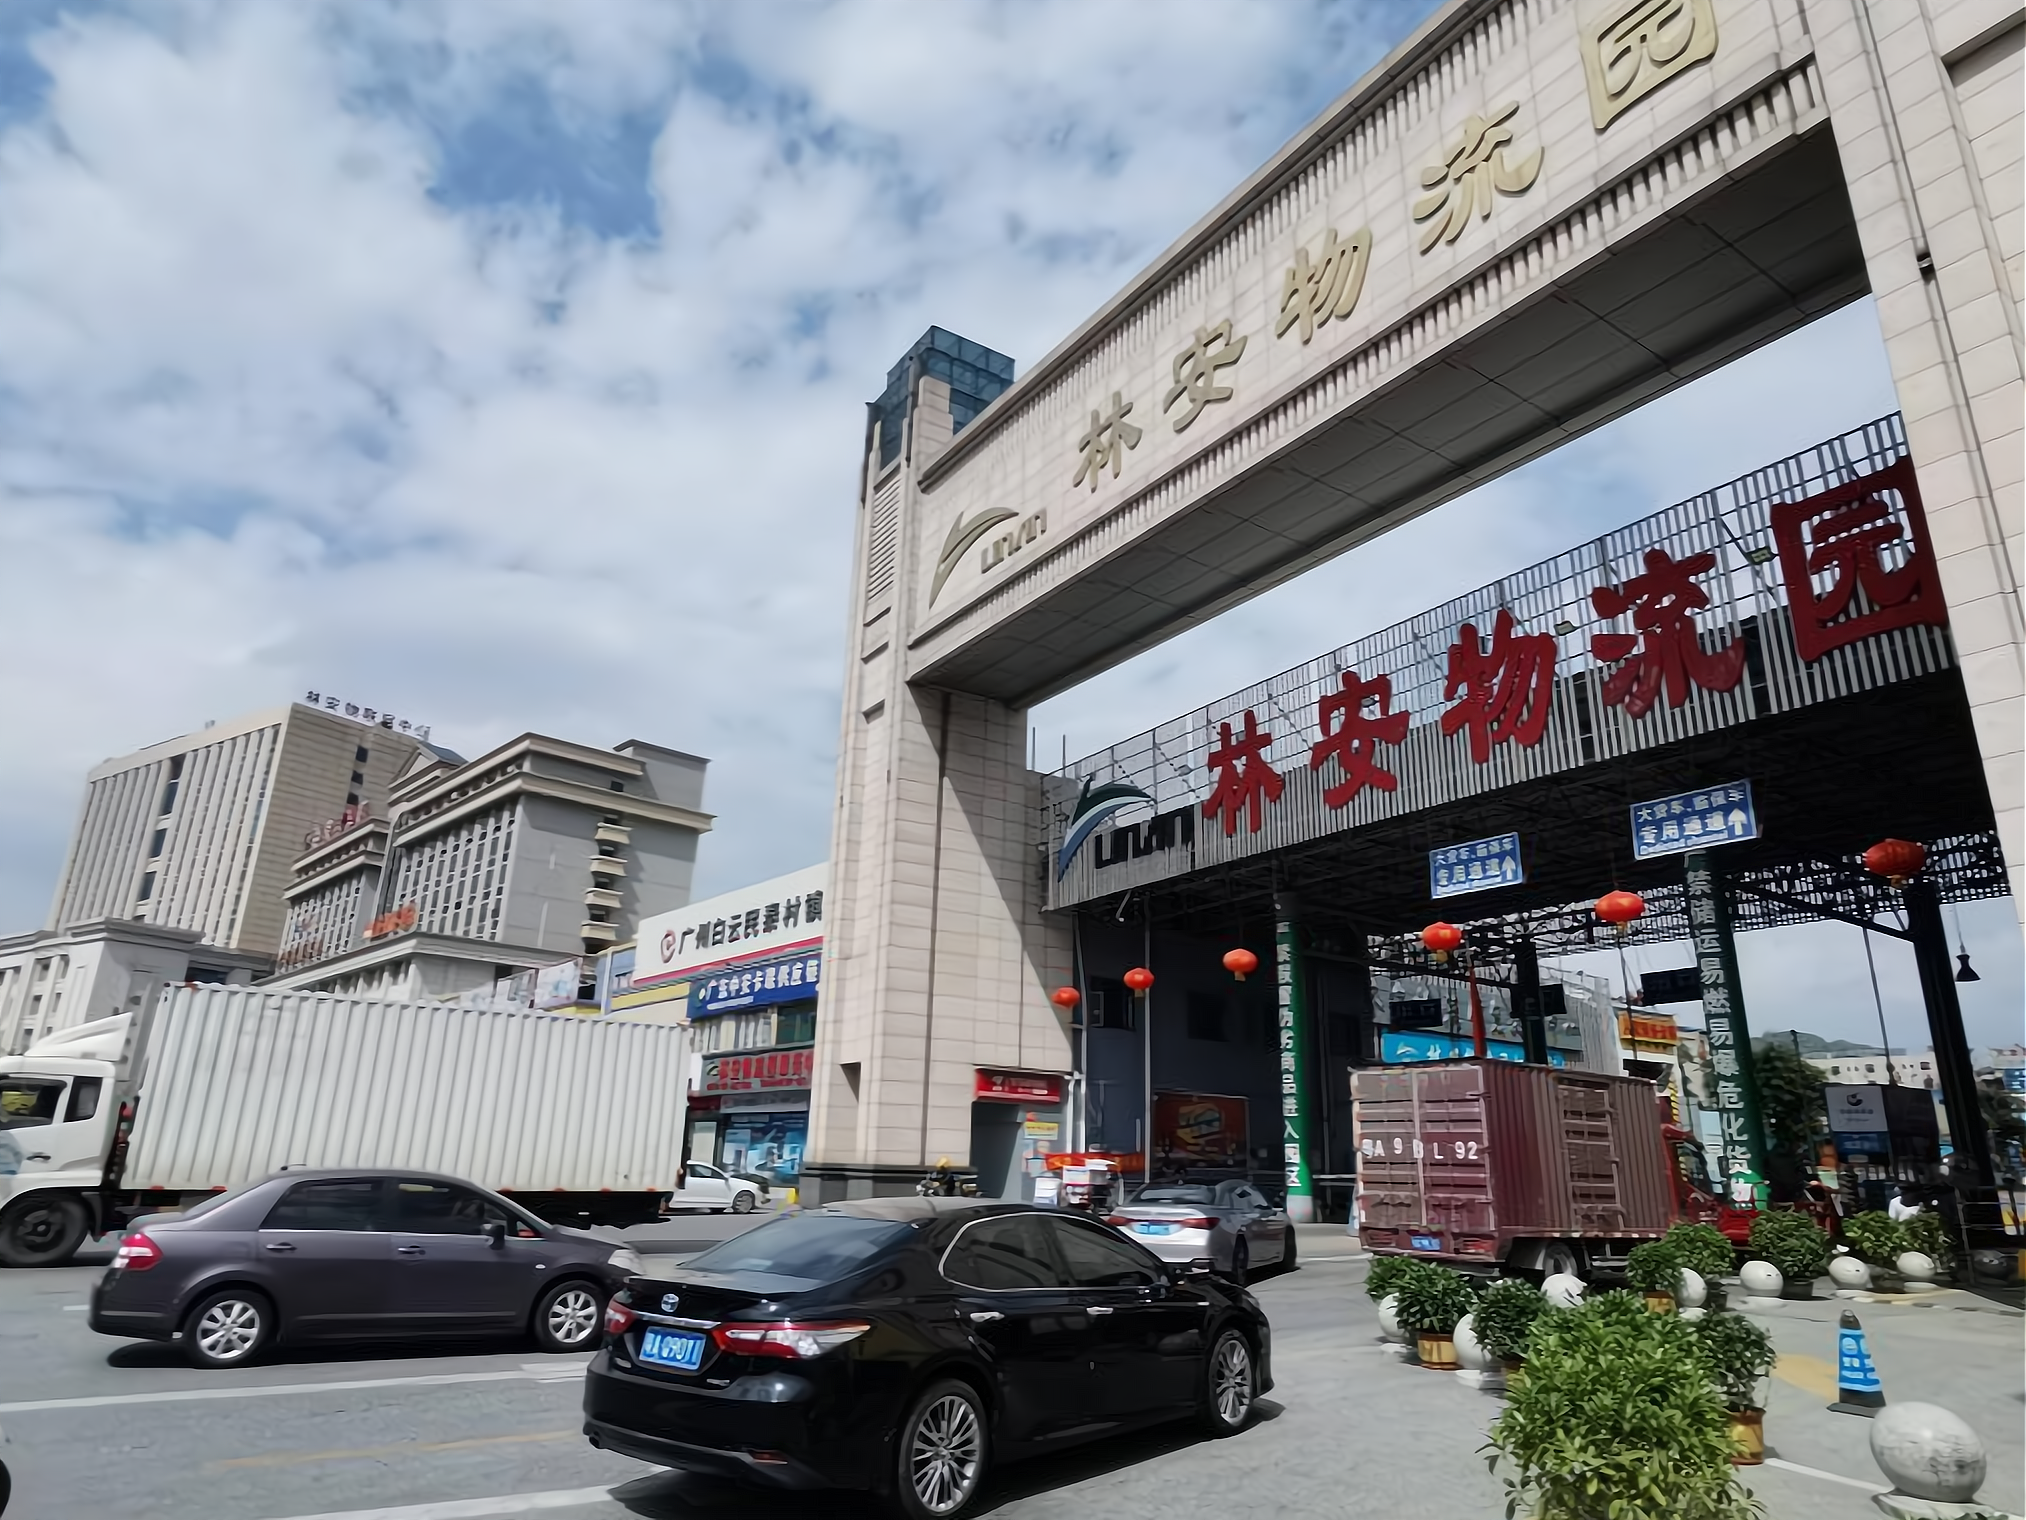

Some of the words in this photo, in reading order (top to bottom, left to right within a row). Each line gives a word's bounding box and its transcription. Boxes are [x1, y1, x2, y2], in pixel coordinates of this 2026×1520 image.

[1073, 0, 1719, 492] 林安物流园
[1202, 455, 1948, 836] 林安物流园
